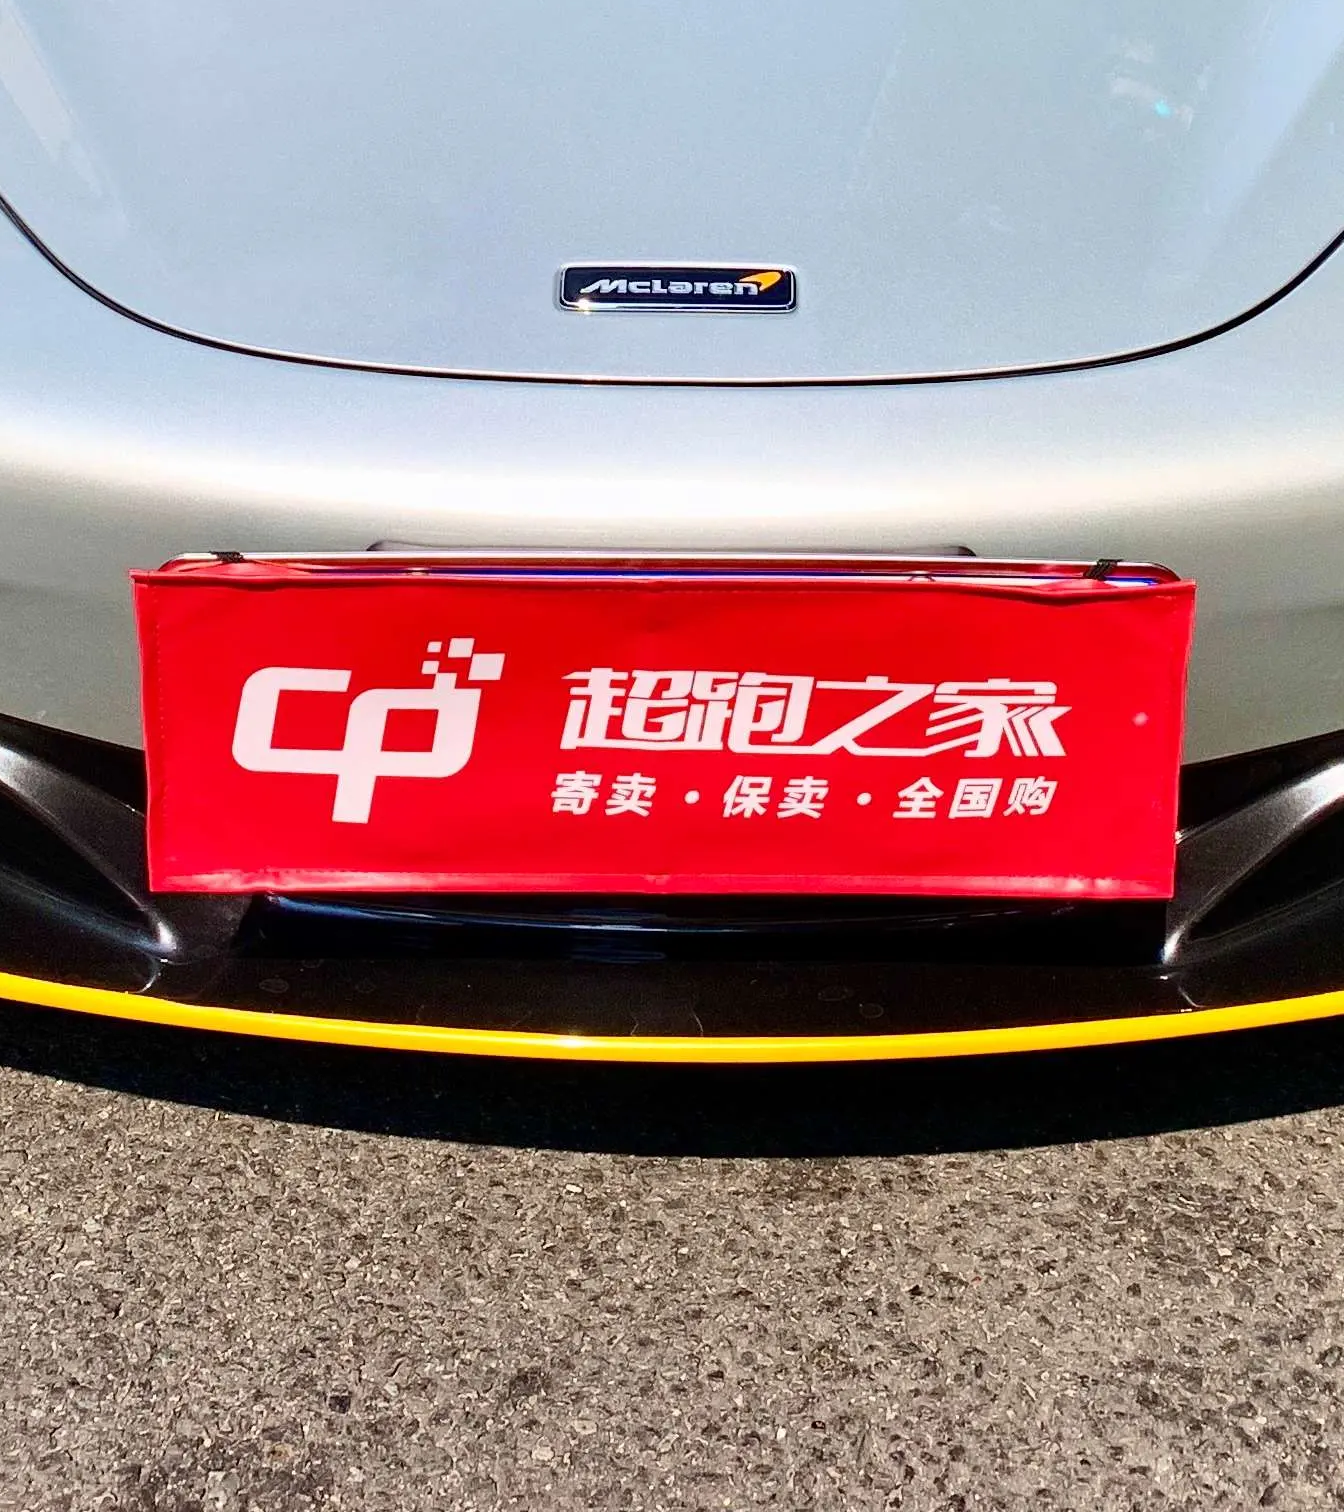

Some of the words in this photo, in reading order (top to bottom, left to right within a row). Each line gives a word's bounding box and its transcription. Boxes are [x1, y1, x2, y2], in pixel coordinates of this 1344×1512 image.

[579, 278, 759, 296] McLaren
[560, 667, 1072, 757] 超跑之家
